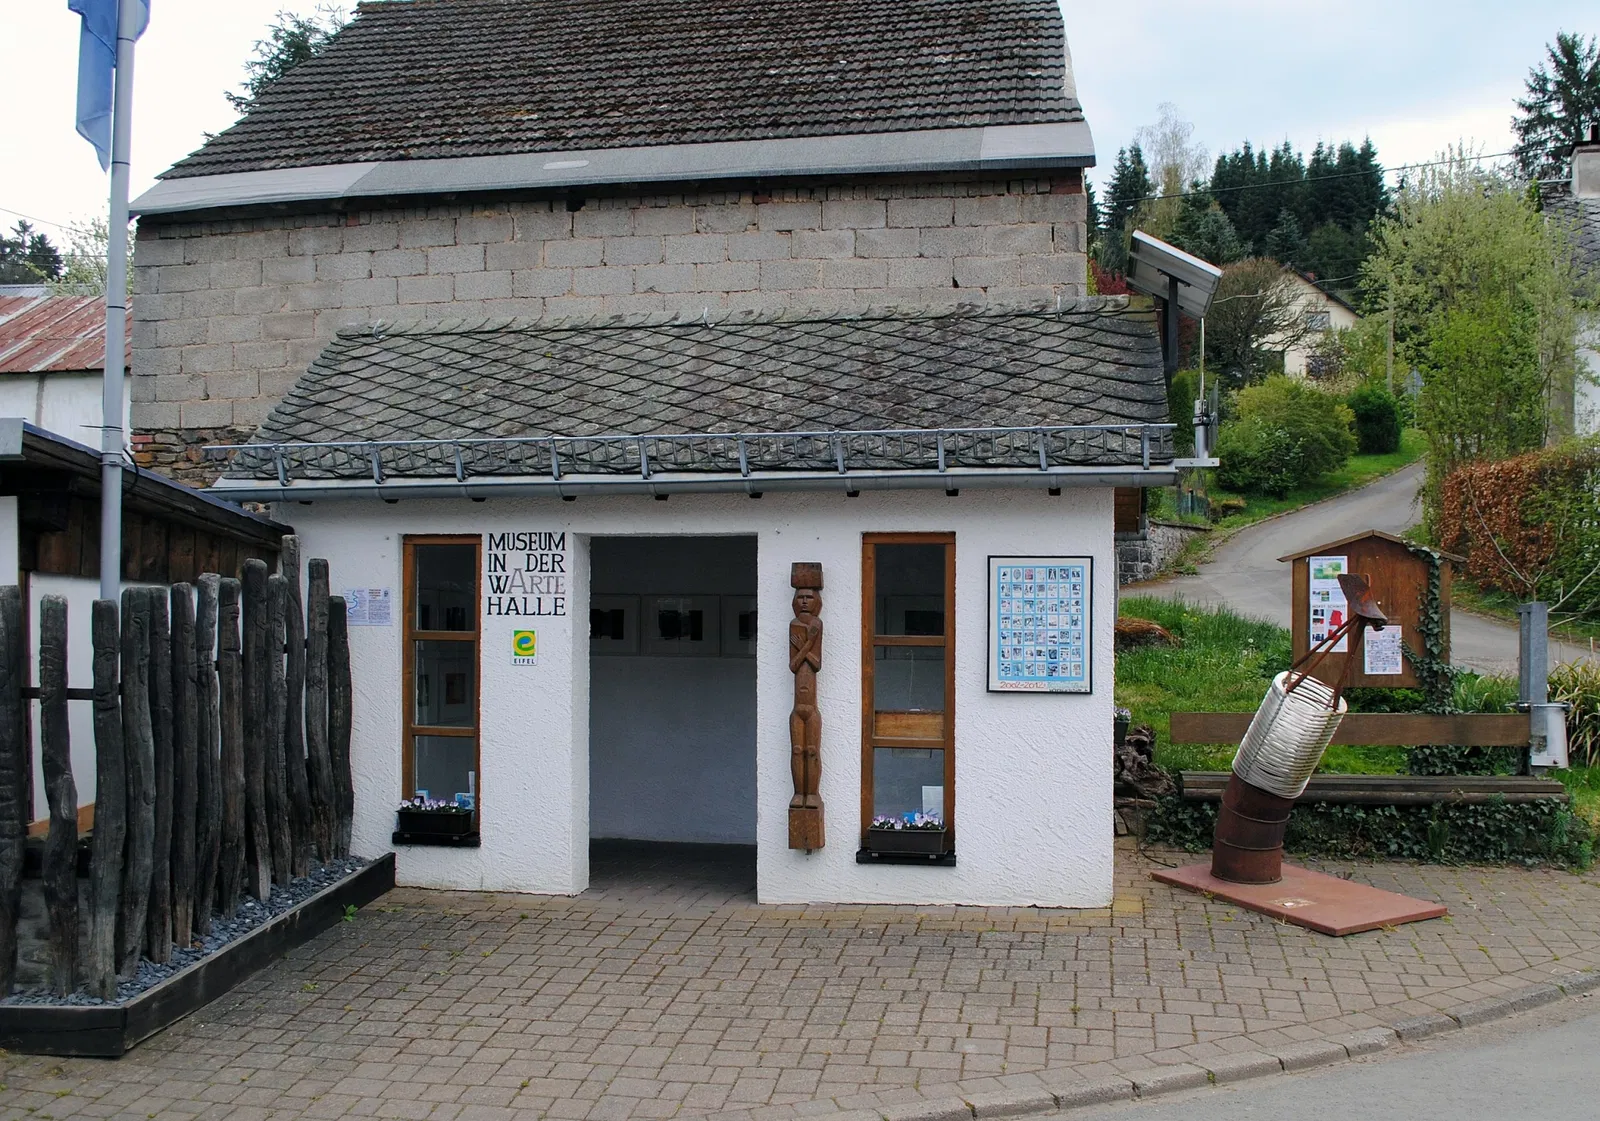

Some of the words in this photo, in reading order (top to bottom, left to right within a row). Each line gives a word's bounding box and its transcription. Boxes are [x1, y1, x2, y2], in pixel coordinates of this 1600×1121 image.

[488, 532, 566, 551] MUSEUM
[488, 553, 506, 572] IN
[525, 553, 566, 573] DER
[487, 596, 566, 616] HALLE
